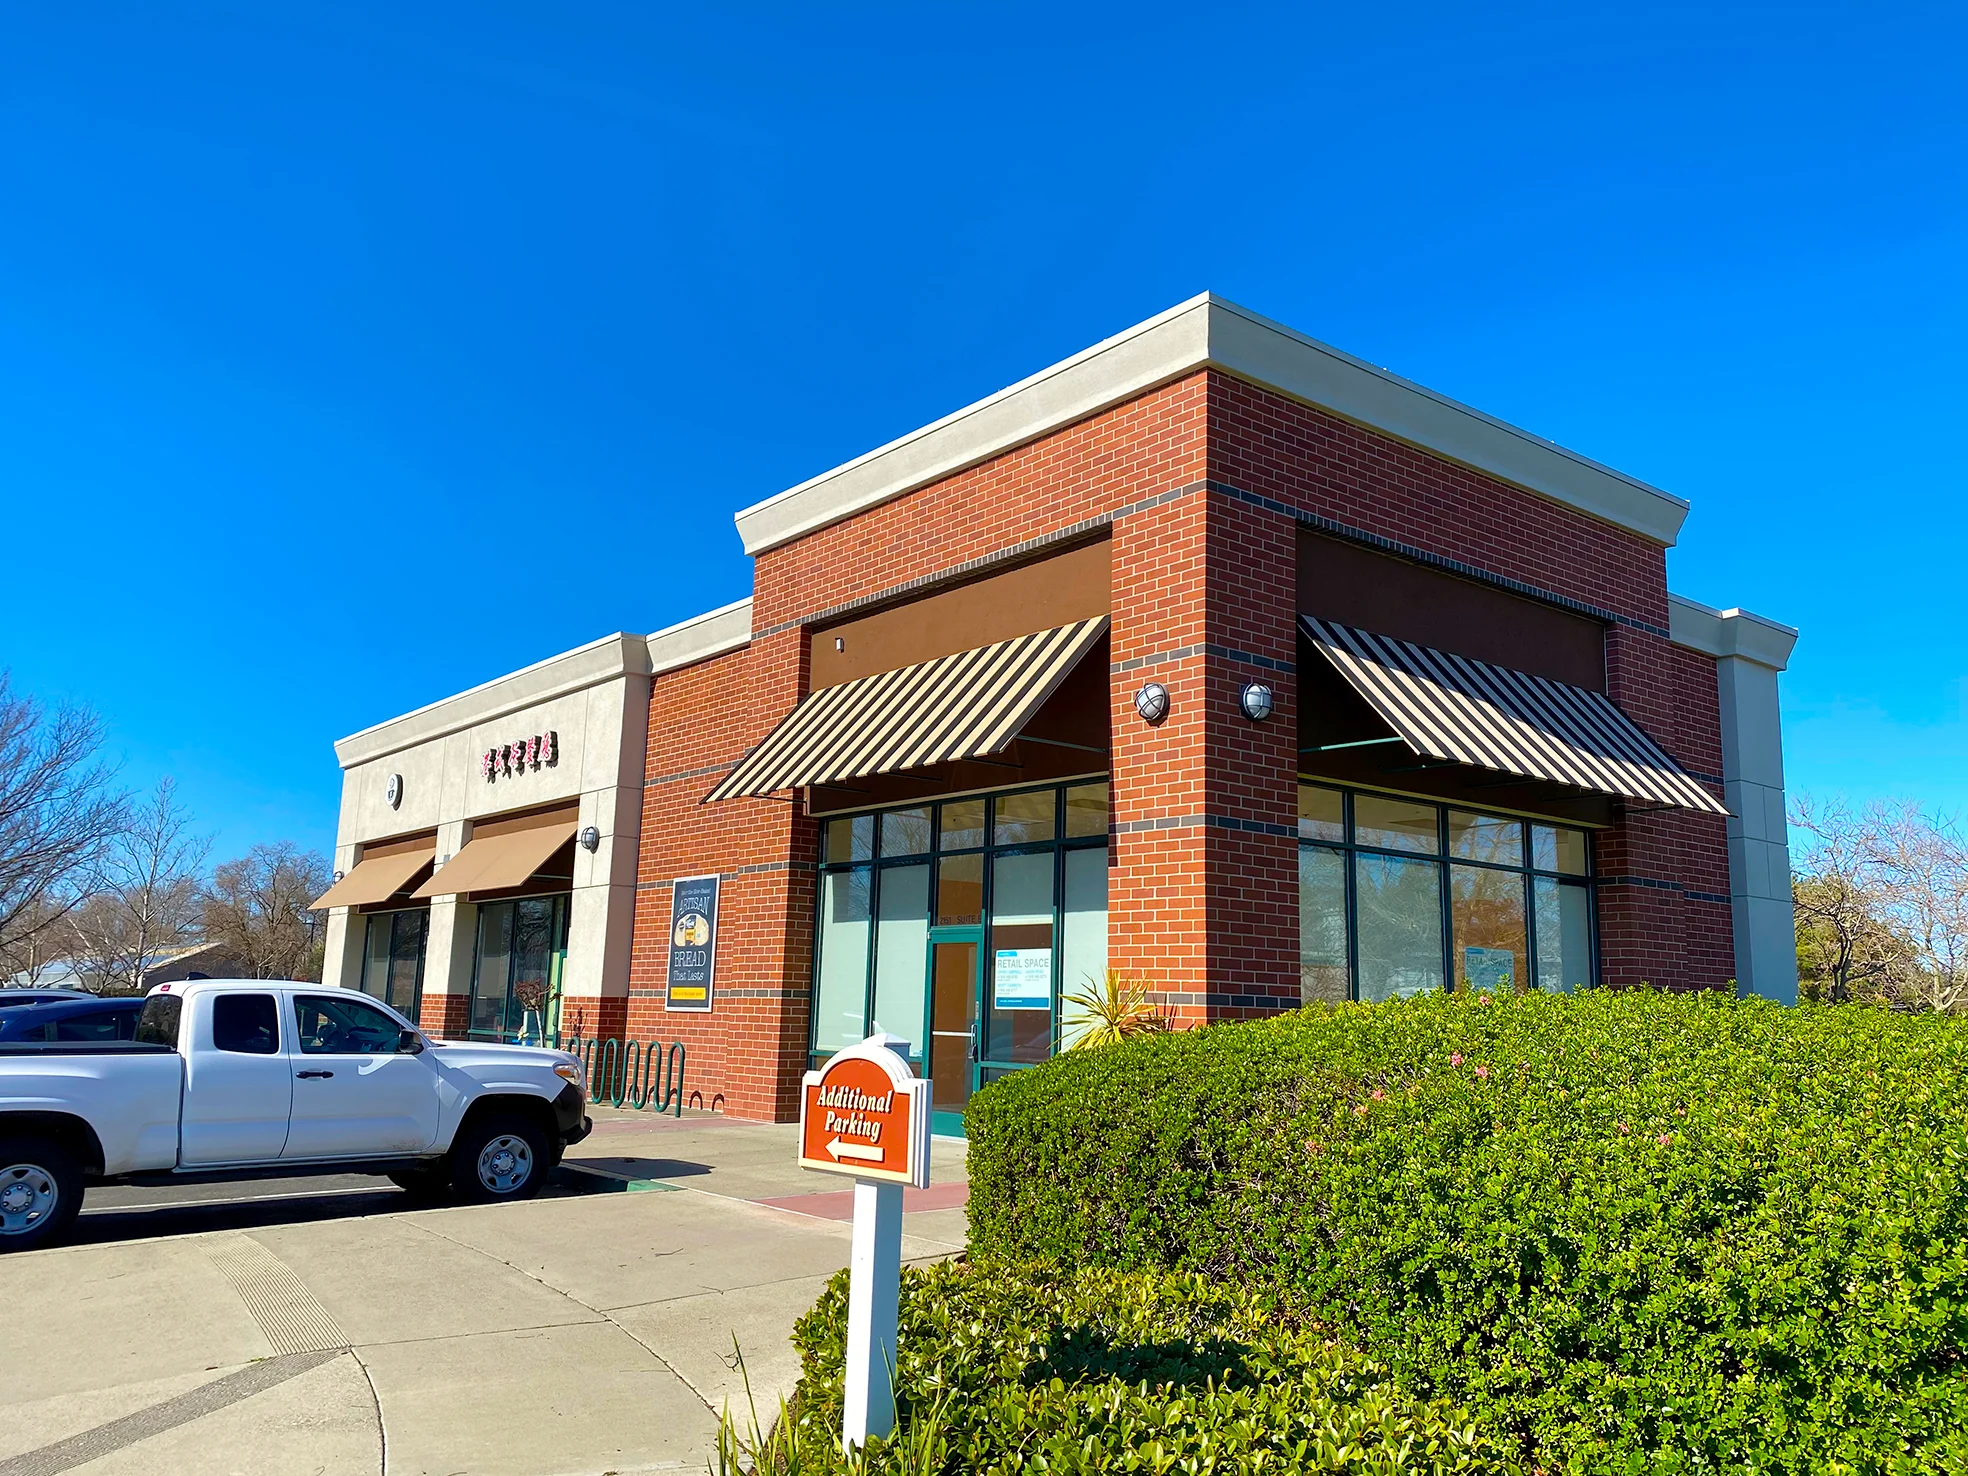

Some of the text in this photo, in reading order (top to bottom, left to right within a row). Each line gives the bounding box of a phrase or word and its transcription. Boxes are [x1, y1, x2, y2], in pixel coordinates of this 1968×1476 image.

[677, 896, 710, 918] ARTISAN
[957, 914, 976, 924] SUITE
[674, 950, 707, 967] BREAD
[997, 958, 1049, 969] RETAIL SPACE
[673, 969, 705, 981] That Lasts
[816, 1084, 893, 1114] Additional
[824, 1110, 881, 1143] Parking
